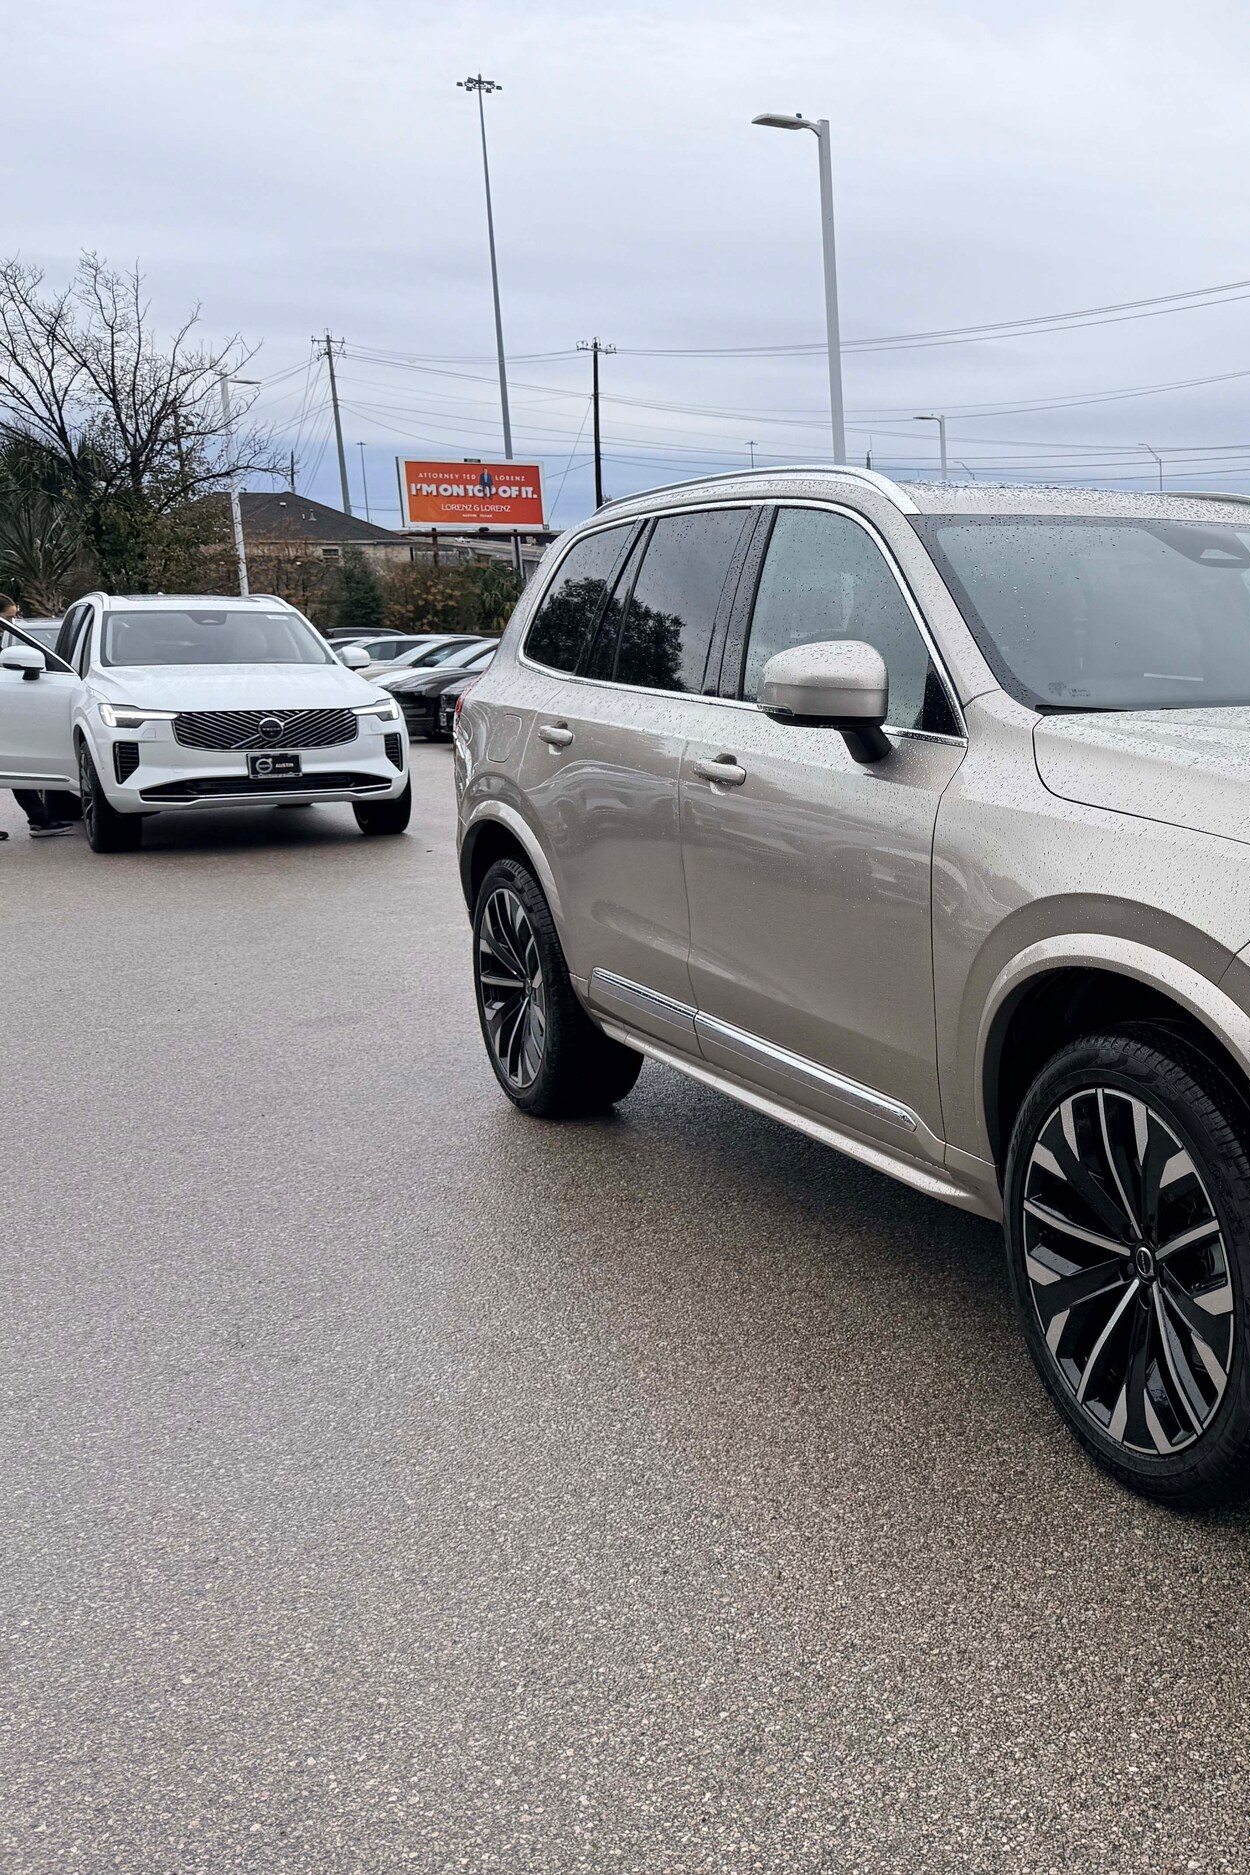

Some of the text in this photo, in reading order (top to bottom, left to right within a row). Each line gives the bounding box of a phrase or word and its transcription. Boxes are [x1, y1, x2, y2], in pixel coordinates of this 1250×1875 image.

[410, 483, 437, 496] I'M
[438, 483, 465, 497] ON
[498, 485, 519, 498] OF
[521, 486, 538, 499] IT.
[441, 503, 473, 511] LORENZ
[480, 504, 511, 513] LORENZ
